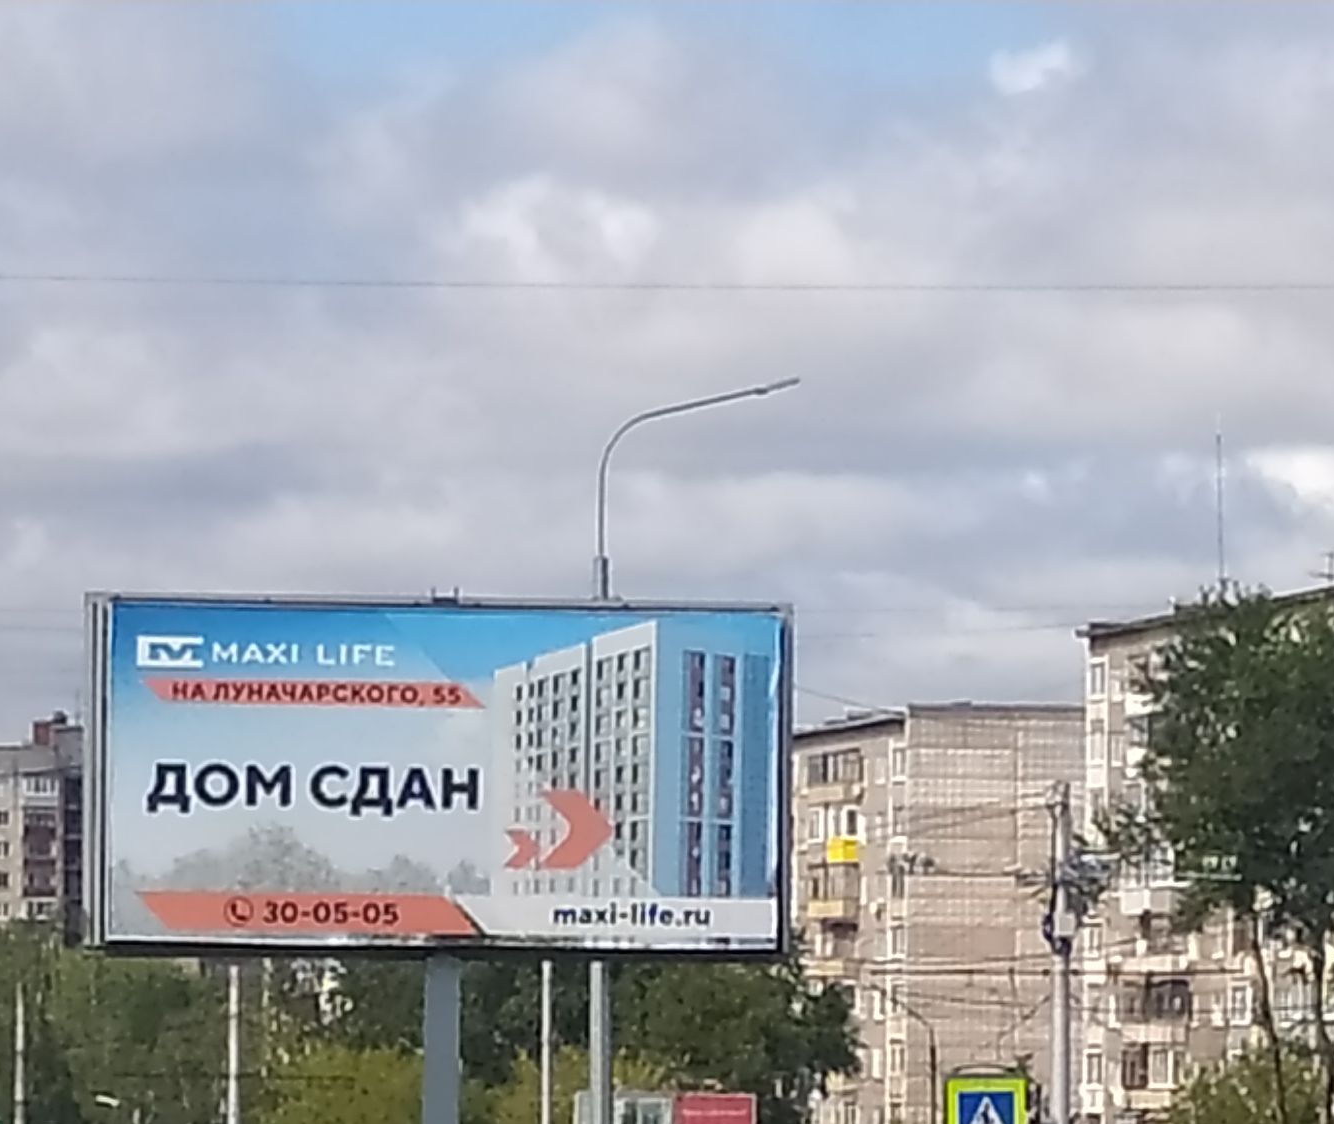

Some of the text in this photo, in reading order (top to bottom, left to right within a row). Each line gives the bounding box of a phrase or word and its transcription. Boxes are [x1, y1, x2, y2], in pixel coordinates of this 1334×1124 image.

[212, 642, 395, 667] MAXI LIFE
[171, 681, 462, 707] НА ЛУНАЧАРСКОГО, 55
[146, 763, 480, 818] ДОМ СДАН
[261, 901, 400, 926] 30-05-05
[552, 901, 711, 928] maxi-life.ru
